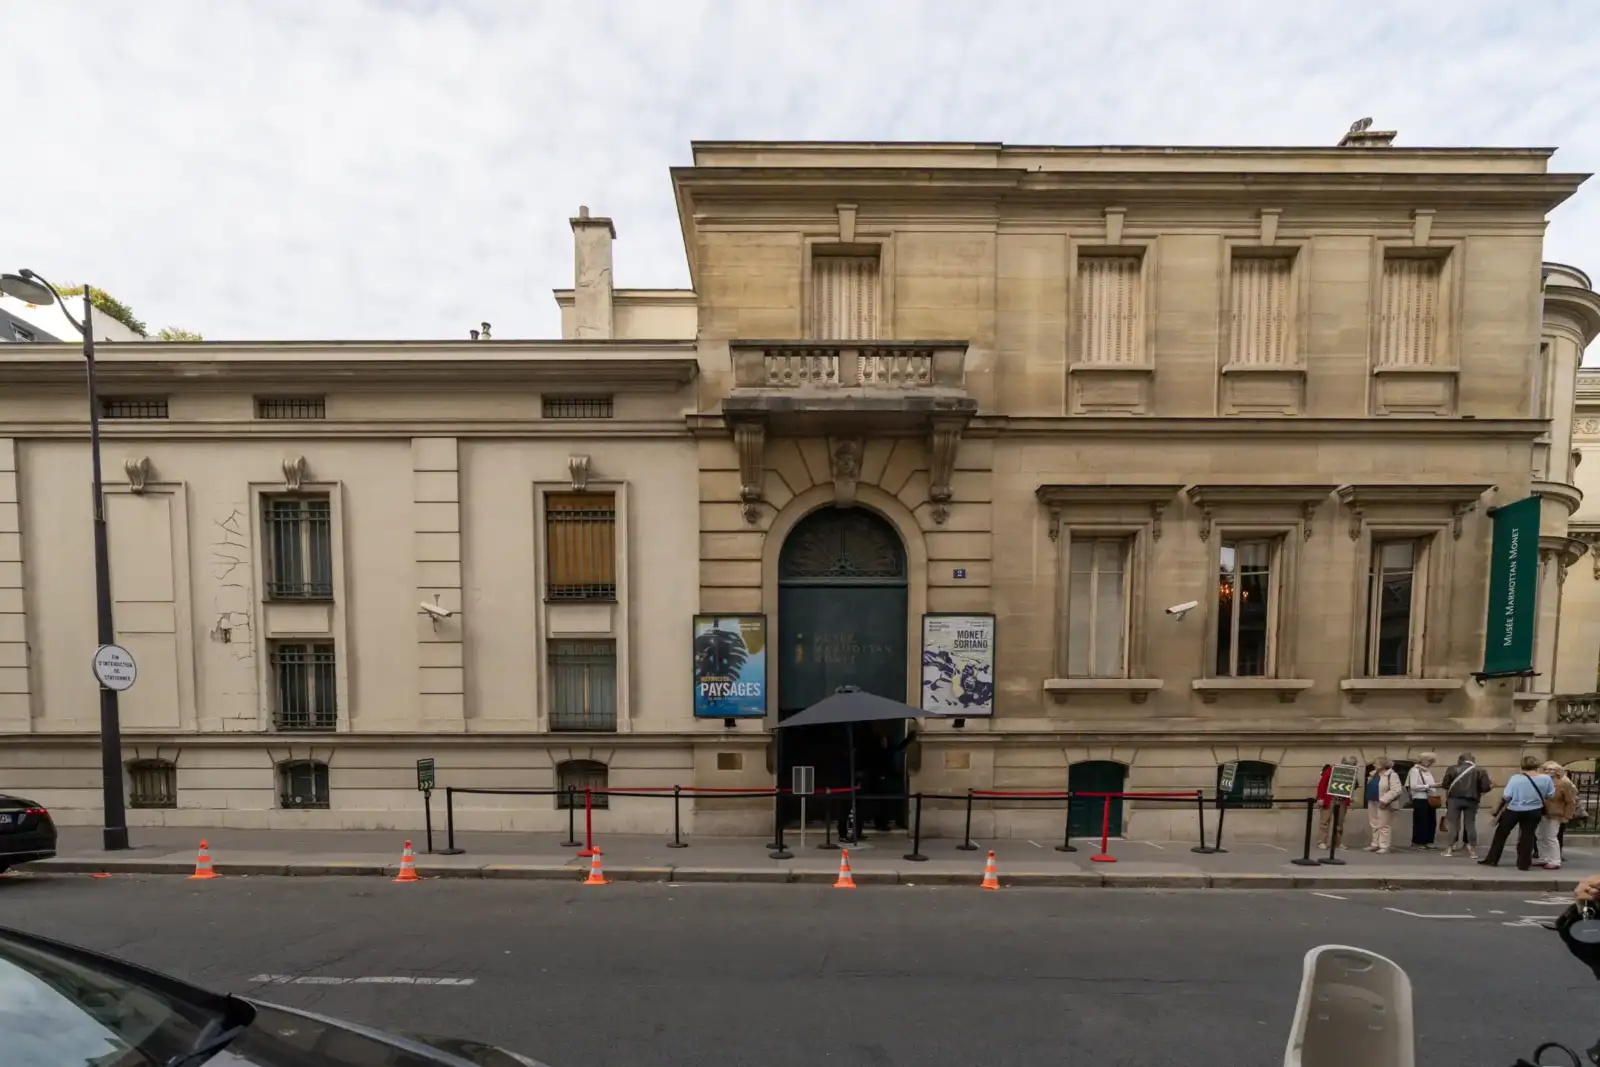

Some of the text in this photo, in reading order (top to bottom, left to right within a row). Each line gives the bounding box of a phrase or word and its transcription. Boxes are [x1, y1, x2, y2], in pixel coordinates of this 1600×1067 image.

[1503, 528, 1519, 646] MUSÉE MARMOTTAN MONET
[953, 639, 989, 649] SORIANO
[700, 682, 761, 697] PAYSAGES
